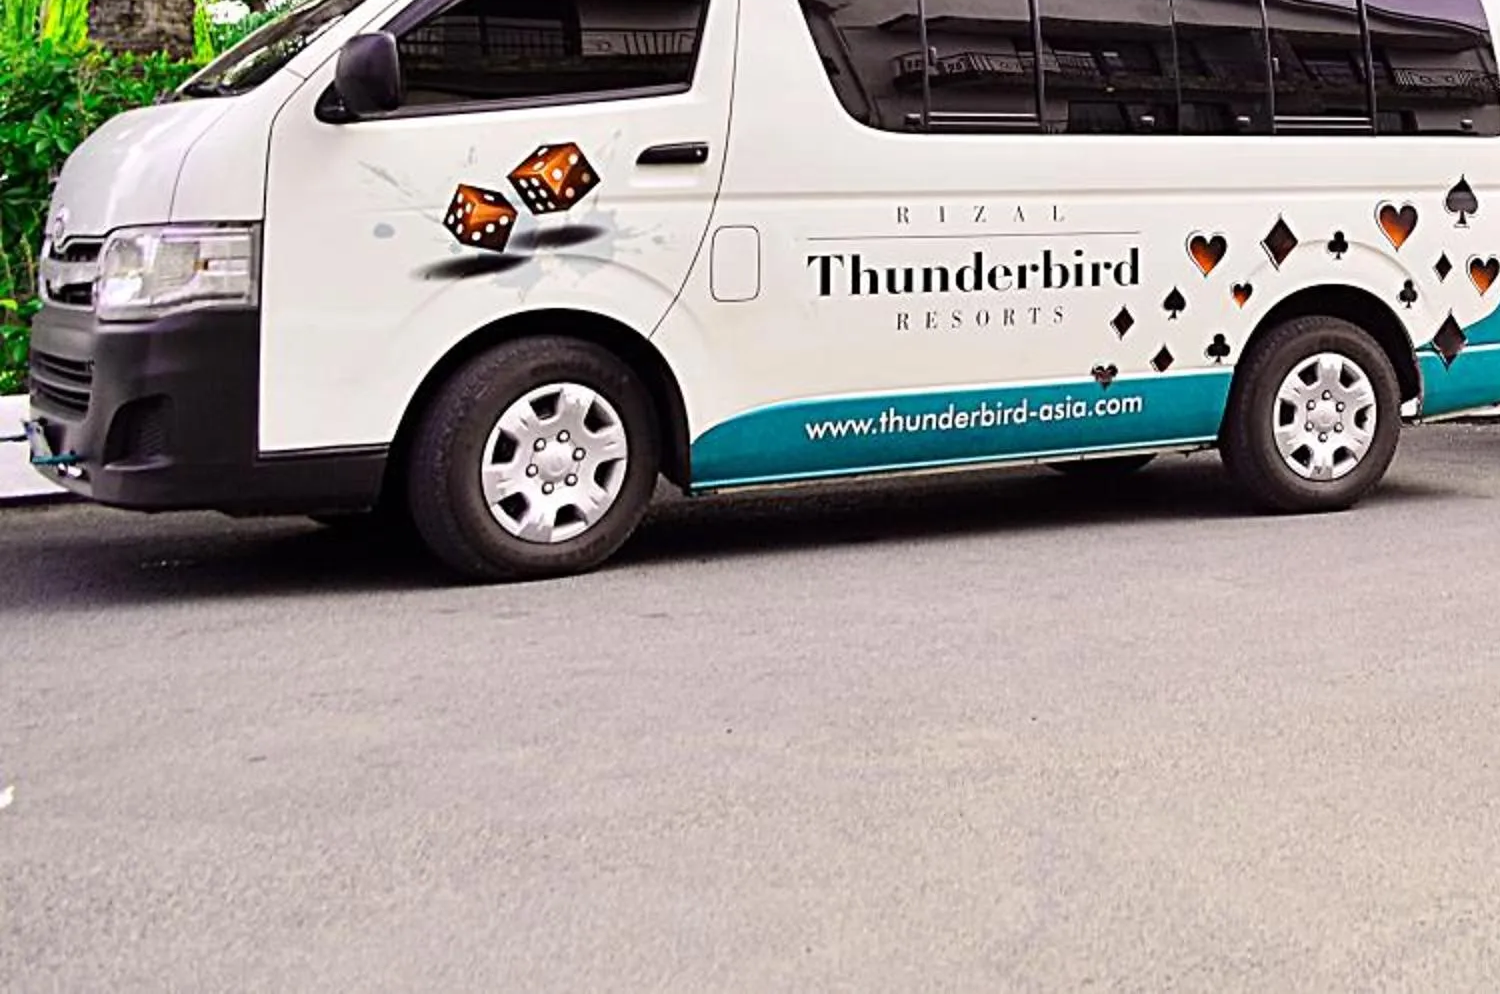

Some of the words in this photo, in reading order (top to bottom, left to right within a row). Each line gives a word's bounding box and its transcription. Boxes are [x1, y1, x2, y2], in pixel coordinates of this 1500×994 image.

[896, 204, 1067, 224] RIZAL
[806, 247, 1140, 297] Thunderbird
[896, 305, 1065, 331] RESORTS
[805, 395, 1143, 440] www.thunderbird-asia.com
